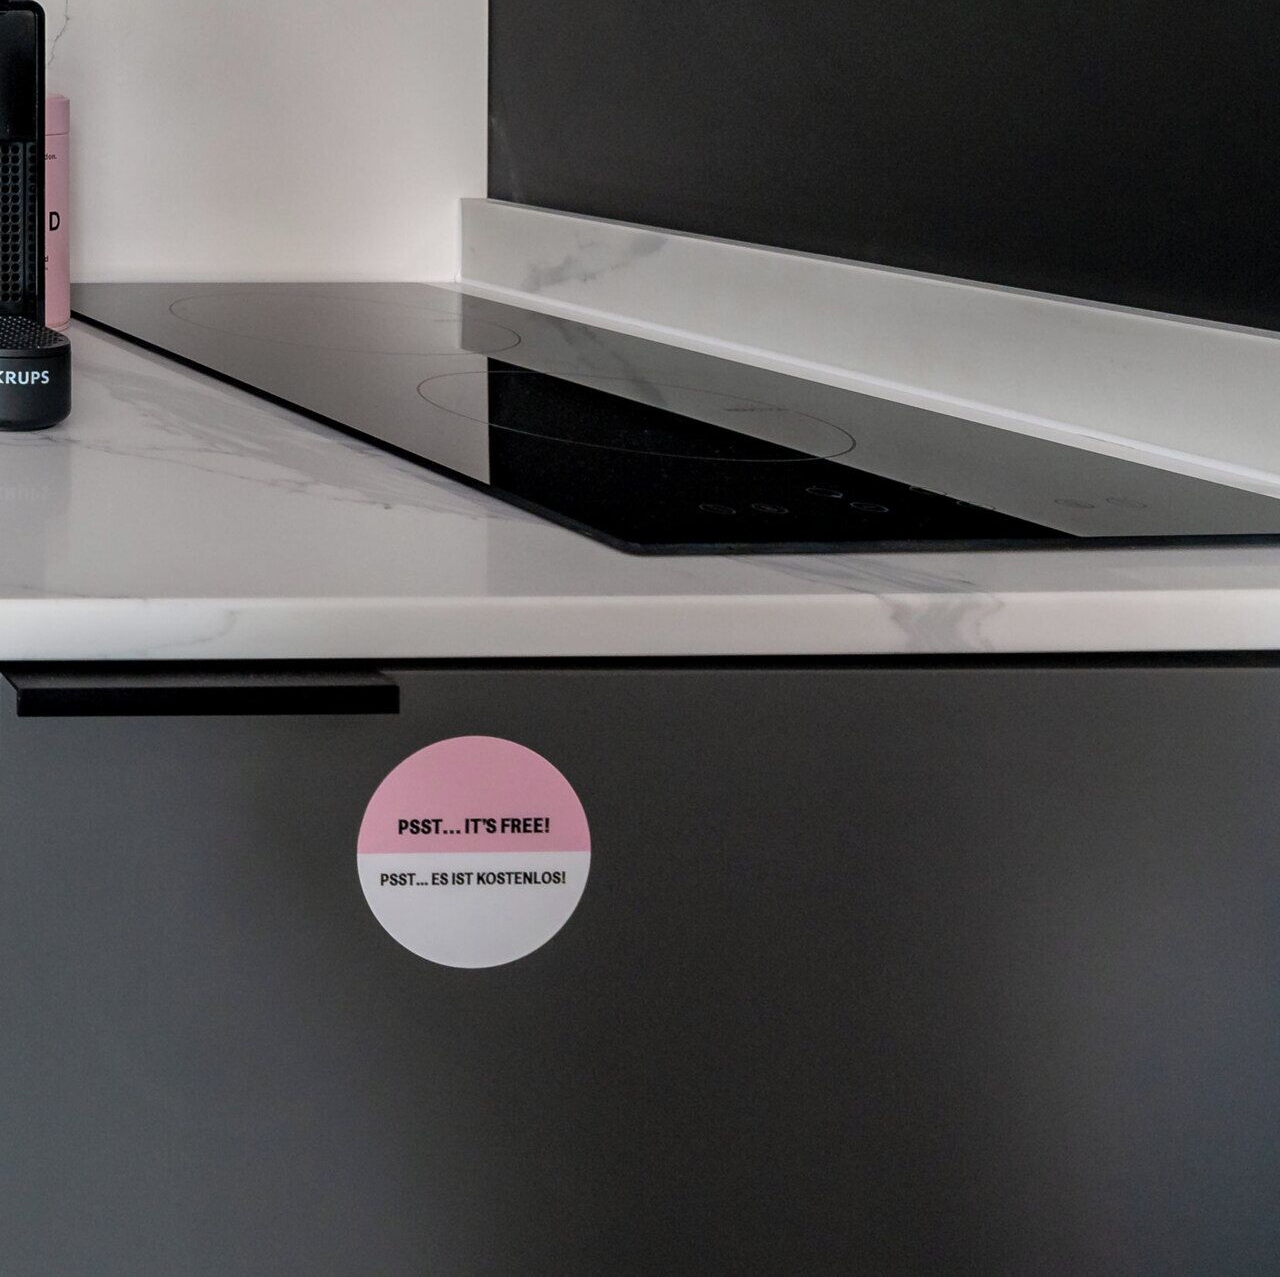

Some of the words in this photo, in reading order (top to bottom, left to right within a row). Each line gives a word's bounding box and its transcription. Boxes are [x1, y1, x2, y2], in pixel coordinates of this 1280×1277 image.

[398, 819, 461, 834] PSST...
[465, 818, 497, 834] IT'S
[501, 817, 550, 833] FREE!
[380, 873, 429, 886] PSST...
[431, 873, 449, 885] ES
[452, 872, 473, 885] IST
[476, 871, 566, 885] KOSTENLOS!
